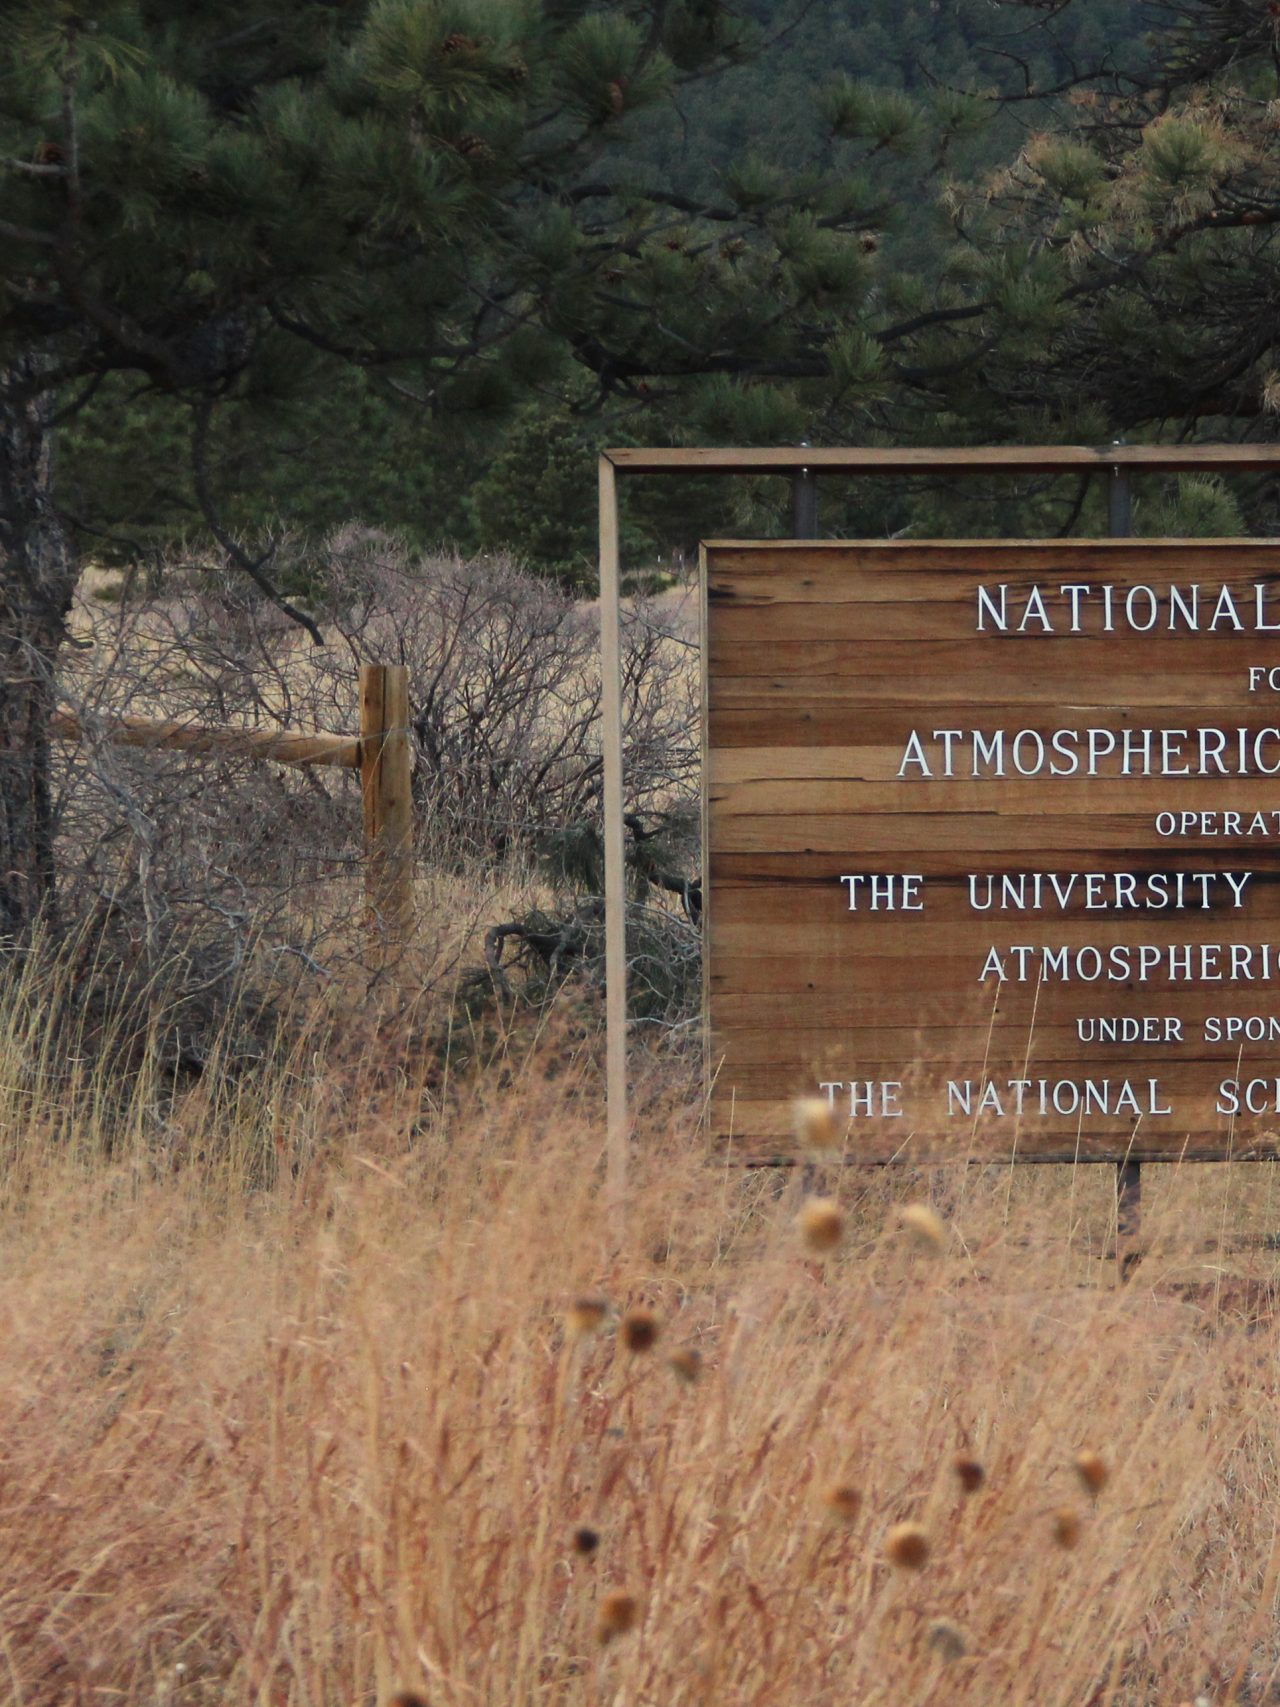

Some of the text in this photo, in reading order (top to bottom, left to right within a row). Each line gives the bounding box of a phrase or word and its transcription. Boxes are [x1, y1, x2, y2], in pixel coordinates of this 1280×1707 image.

[840, 874, 924, 911] THE
[968, 872, 1252, 910] UNIVERSITY
[1076, 1017, 1184, 1042] UNDER
[818, 1080, 904, 1118] THE
[946, 1079, 1172, 1117] NATIONAL
